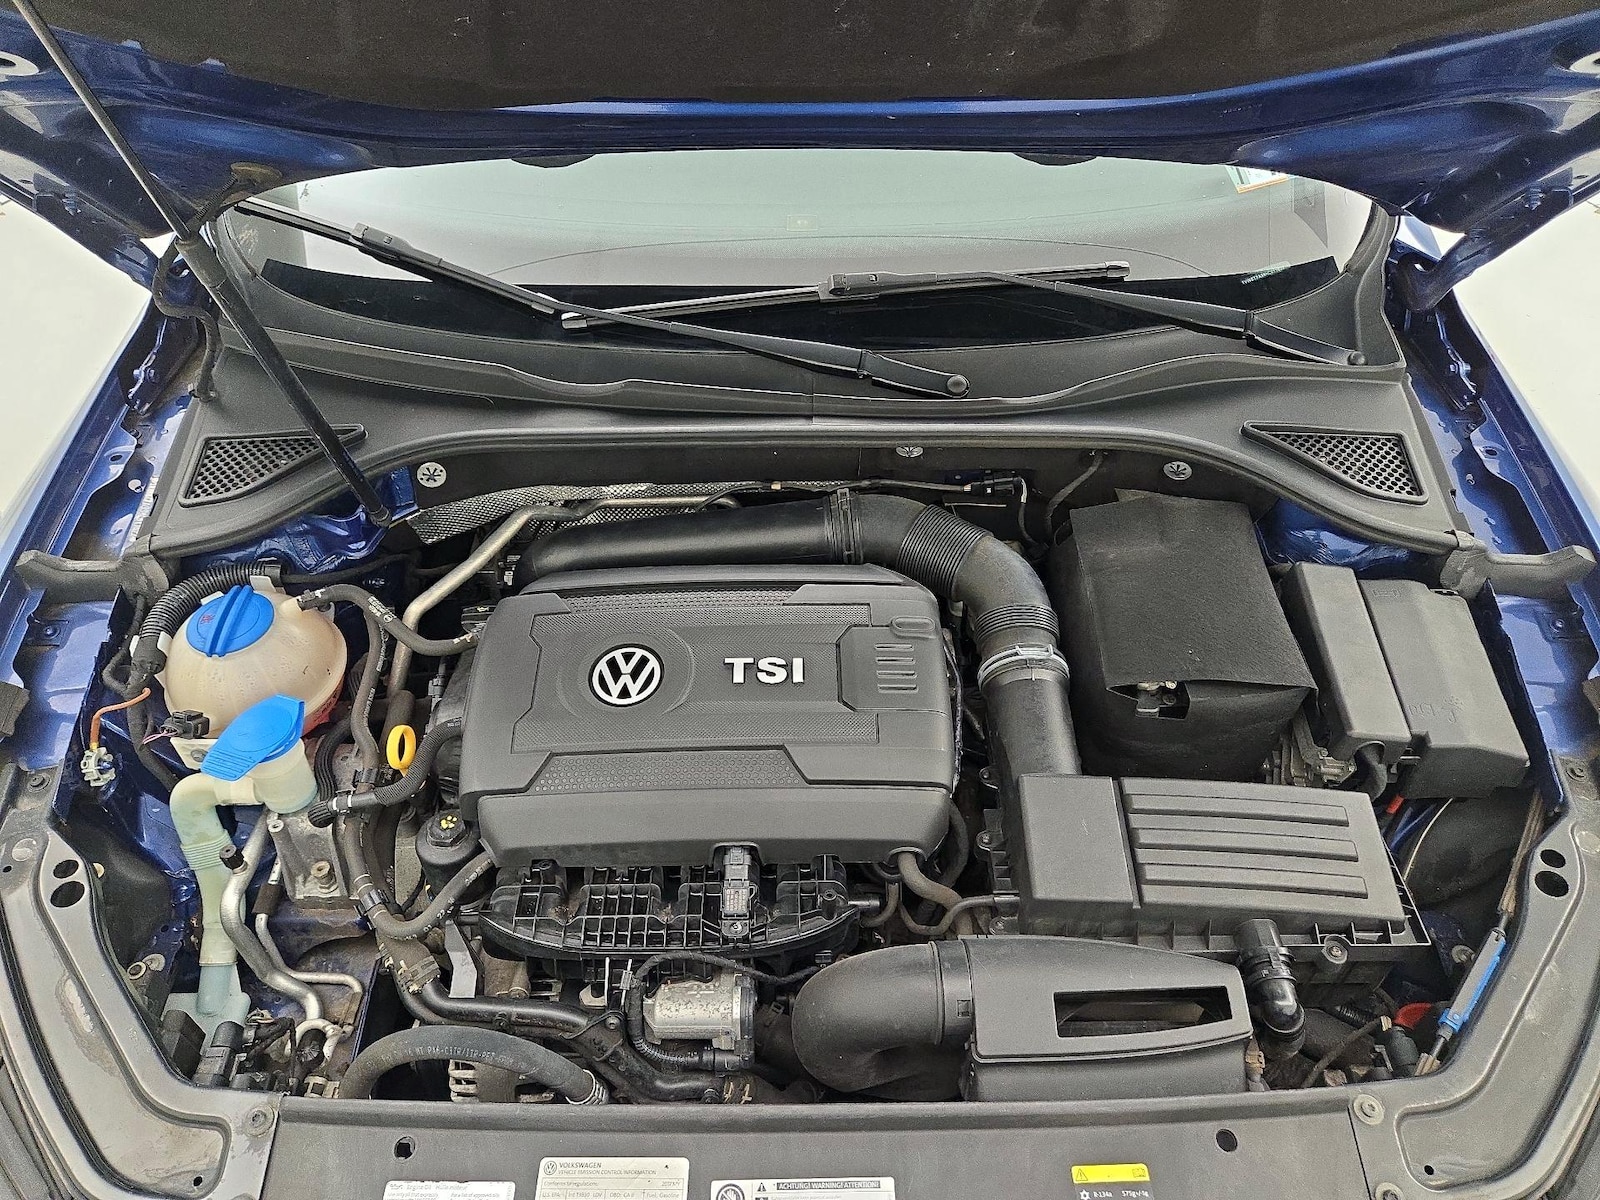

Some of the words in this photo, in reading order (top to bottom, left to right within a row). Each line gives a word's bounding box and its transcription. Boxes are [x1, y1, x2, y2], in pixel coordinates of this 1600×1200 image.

[590, 645, 663, 706] VW
[724, 656, 805, 684] TSI
[811, 1181, 843, 1190] WARNING!
[843, 1180, 880, 1189] ATTENTION!
